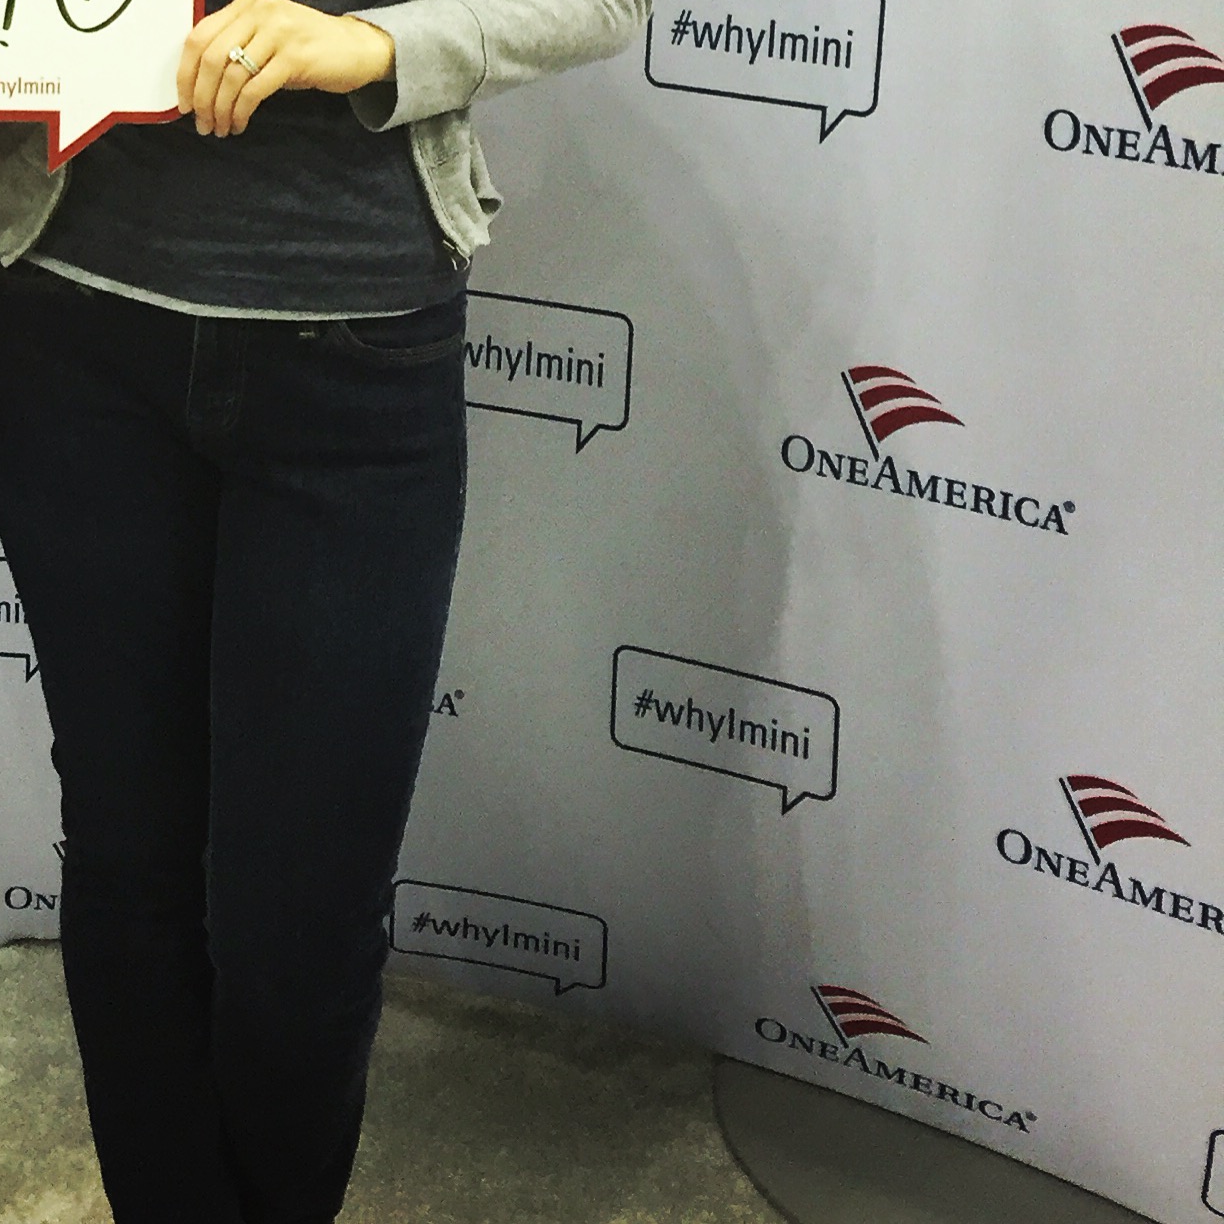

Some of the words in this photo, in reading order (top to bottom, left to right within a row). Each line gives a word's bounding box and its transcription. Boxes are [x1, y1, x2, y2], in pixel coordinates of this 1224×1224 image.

[671, 9, 854, 69] #whyImini
[1043, 110, 1224, 176] ONEAM
[633, 688, 812, 761] #whyImini
[411, 911, 582, 964] #whyImini
